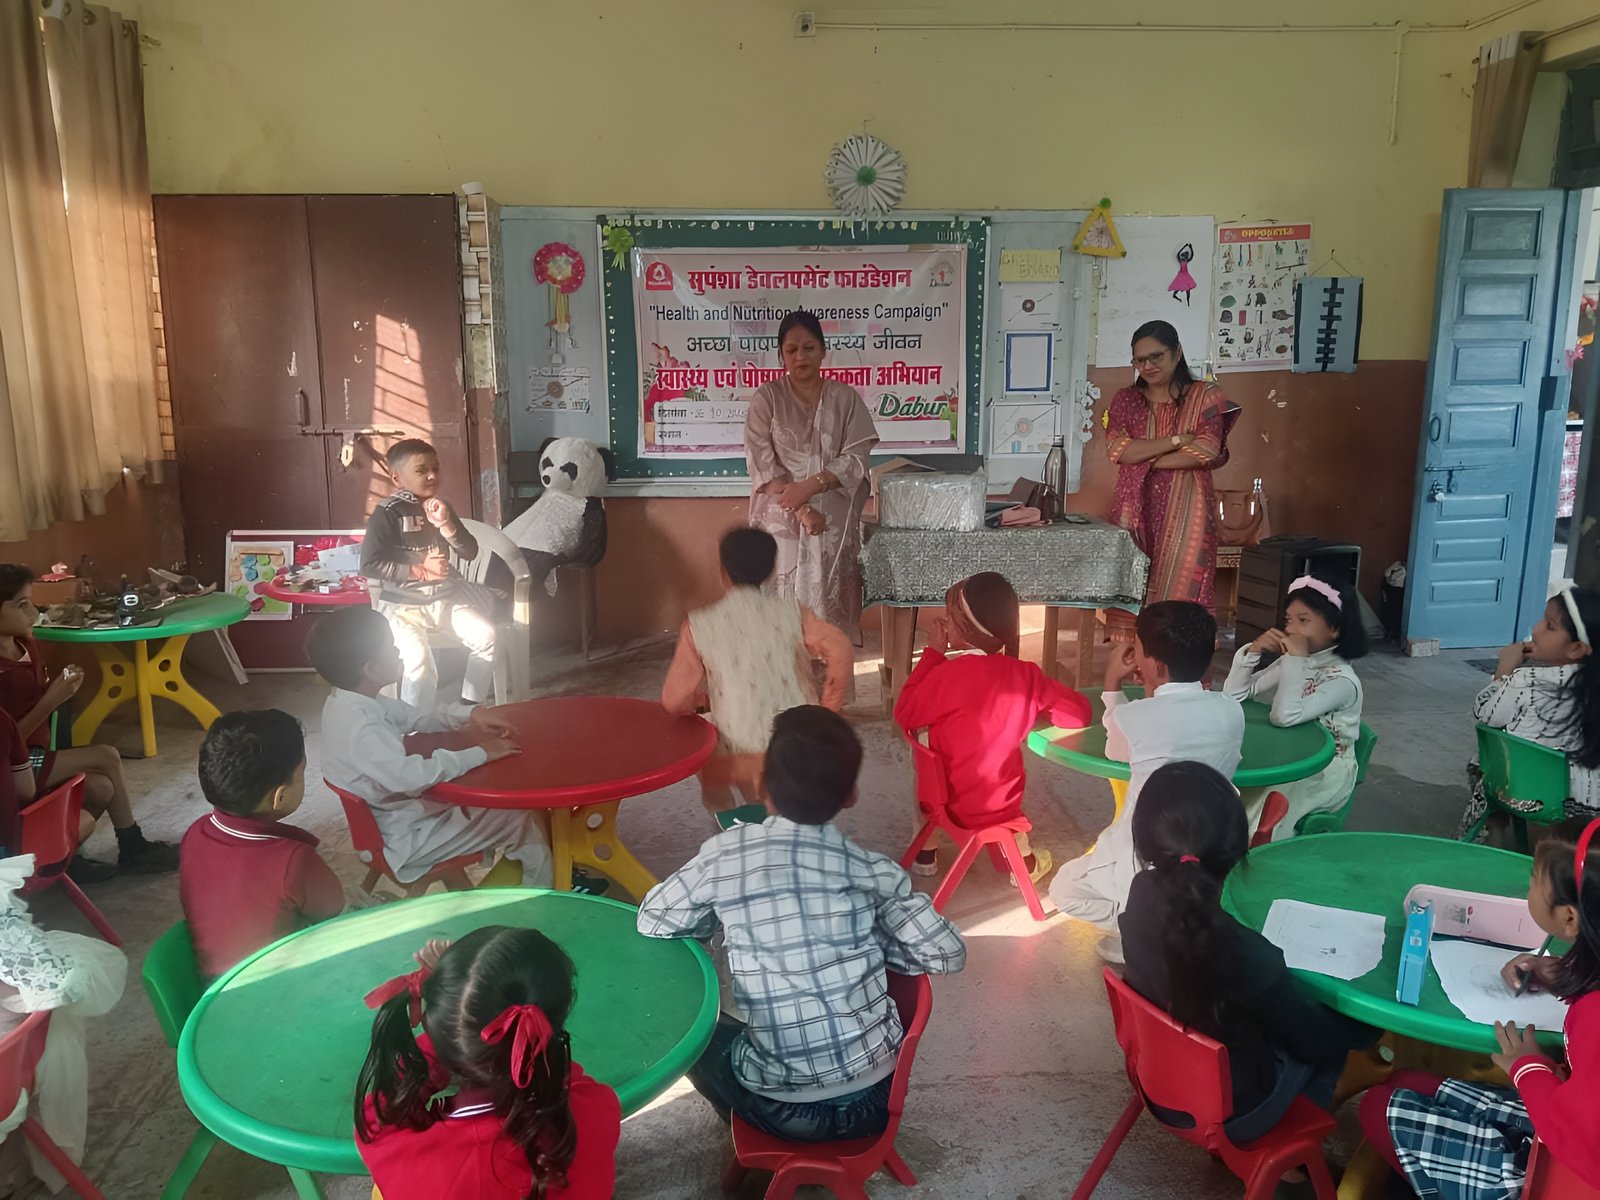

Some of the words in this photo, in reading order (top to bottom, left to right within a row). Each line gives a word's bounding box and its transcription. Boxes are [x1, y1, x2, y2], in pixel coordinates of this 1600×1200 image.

[688, 265, 741, 295] सुपंशा
[745, 265, 831, 290] डेवलपमेंट
[834, 264, 912, 289] फाउंडेशन
[649, 305, 699, 321] "Health
[704, 306, 730, 321] and
[733, 305, 790, 321] Nutrition
[874, 303, 949, 322] Campaign"
[687, 336, 731, 353] अच्छा
[872, 328, 923, 351] जीवन
[713, 362, 739, 389] एवं
[877, 360, 942, 387] अभियान
[879, 393, 948, 419] Dabur
